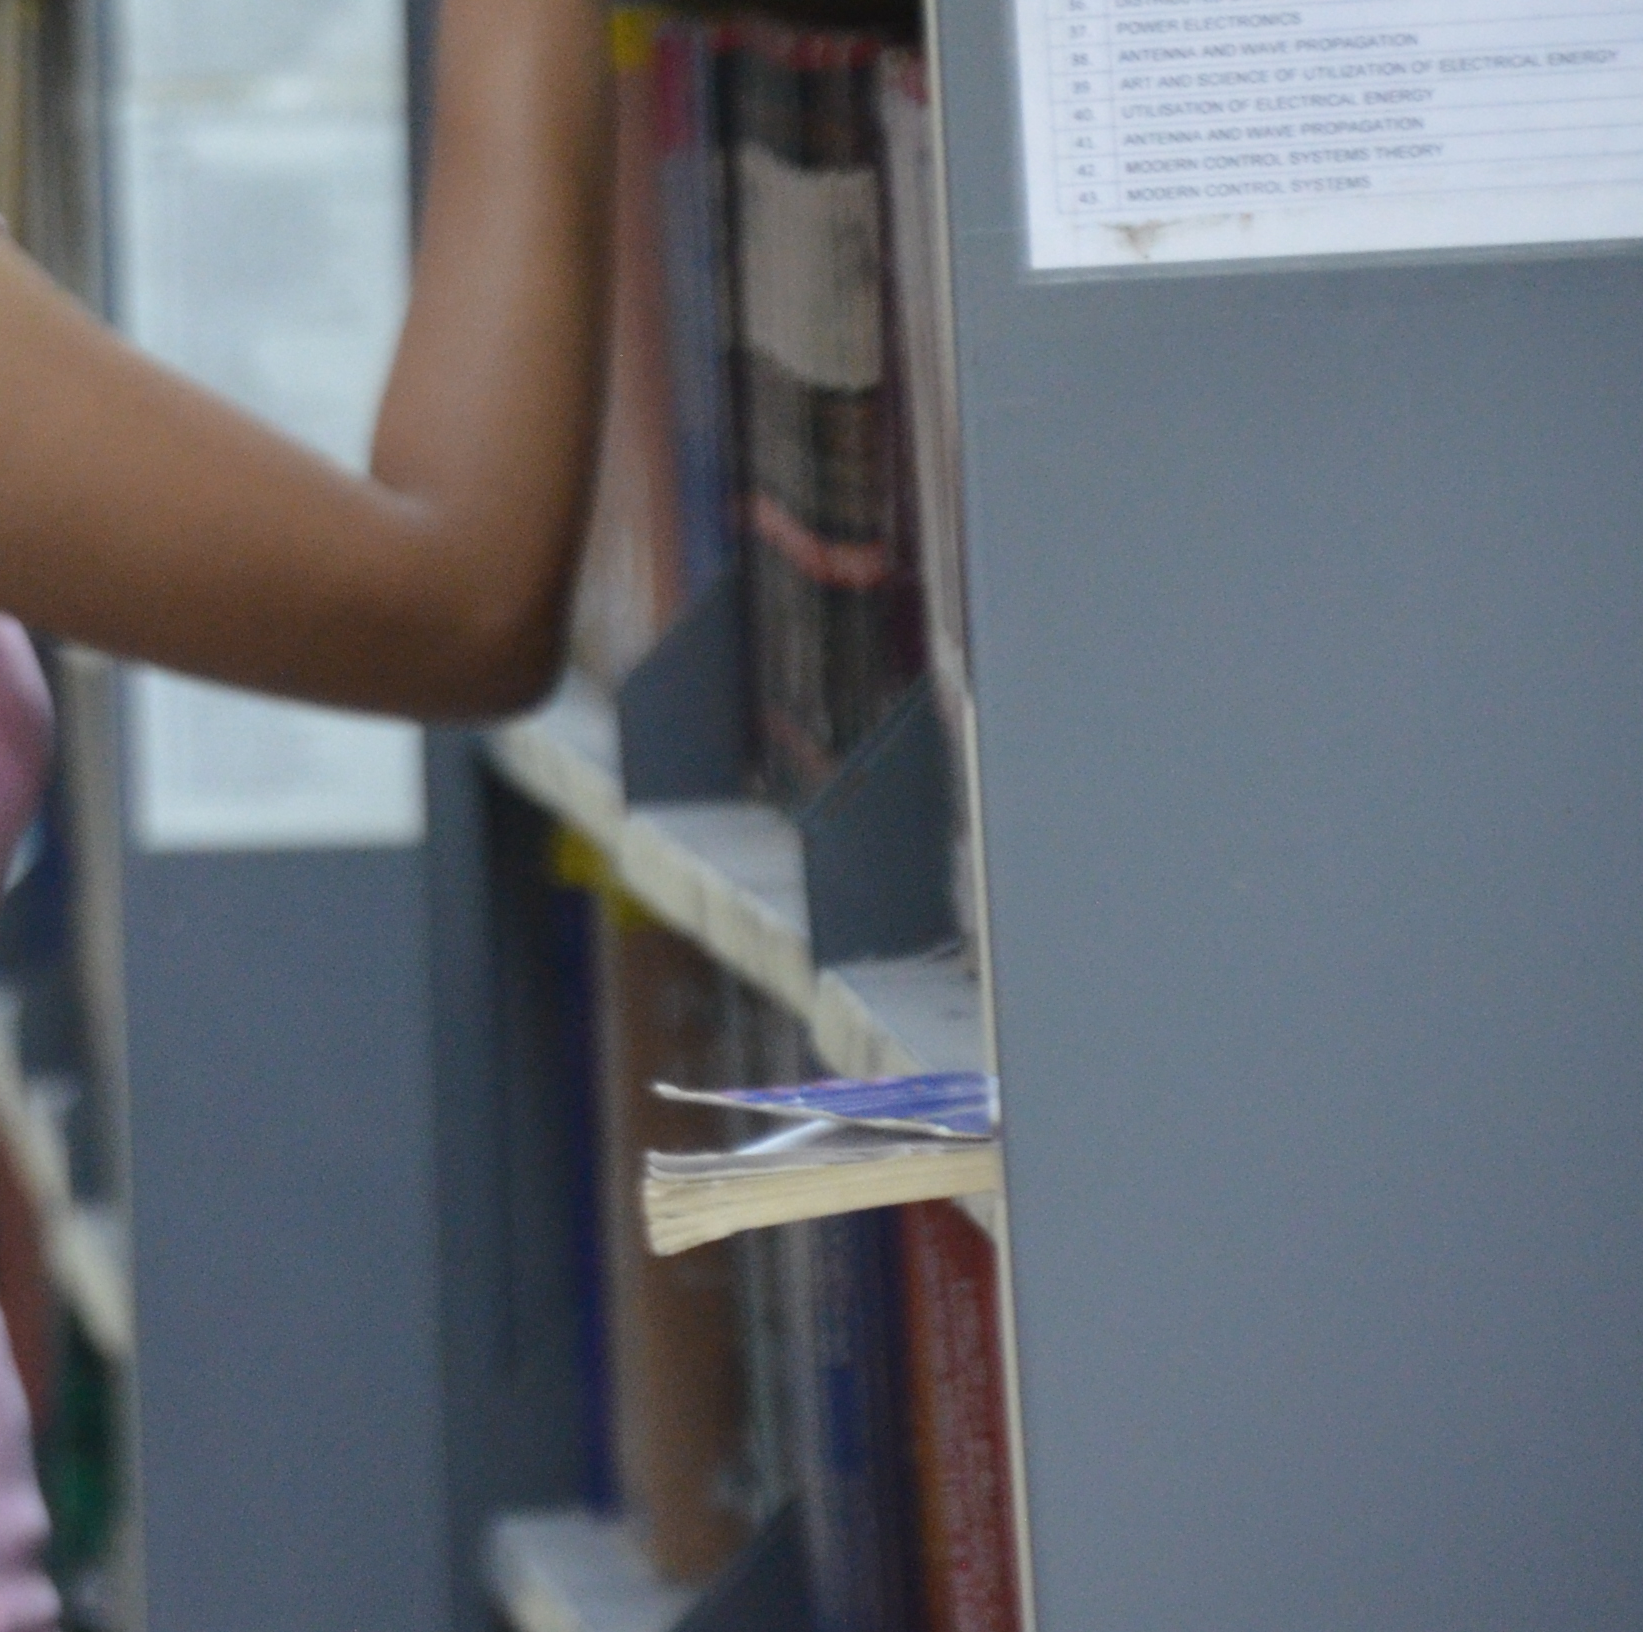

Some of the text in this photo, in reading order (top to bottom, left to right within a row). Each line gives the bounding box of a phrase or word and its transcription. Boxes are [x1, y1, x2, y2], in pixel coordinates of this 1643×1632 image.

[1116, 11, 1302, 36] POWER ELECTRONICS
[1118, 32, 1419, 64] ANTENNA AND WAVE PROPAGATION
[1120, 75, 1152, 91] ART
[1158, 73, 1192, 89] AND
[1198, 69, 1269, 87] SCIENCE
[1275, 67, 1297, 82] OF
[1412, 59, 1433, 74] OF
[1439, 53, 1541, 73] ELECTRICAL
[1547, 48, 1619, 66] ENERGY
[1230, 98, 1250, 113] OF
[1256, 91, 1358, 111] ELECTRICAL
[1364, 87, 1435, 105] ENERGY
[1124, 116, 1425, 147] ANTENNA AND WAVE PROPAGATION
[1125, 142, 1444, 175] MODERN CONTROL SYSTEMS THEORY
[1126, 175, 1372, 202] MODERN CONTROL SYSTEMS
